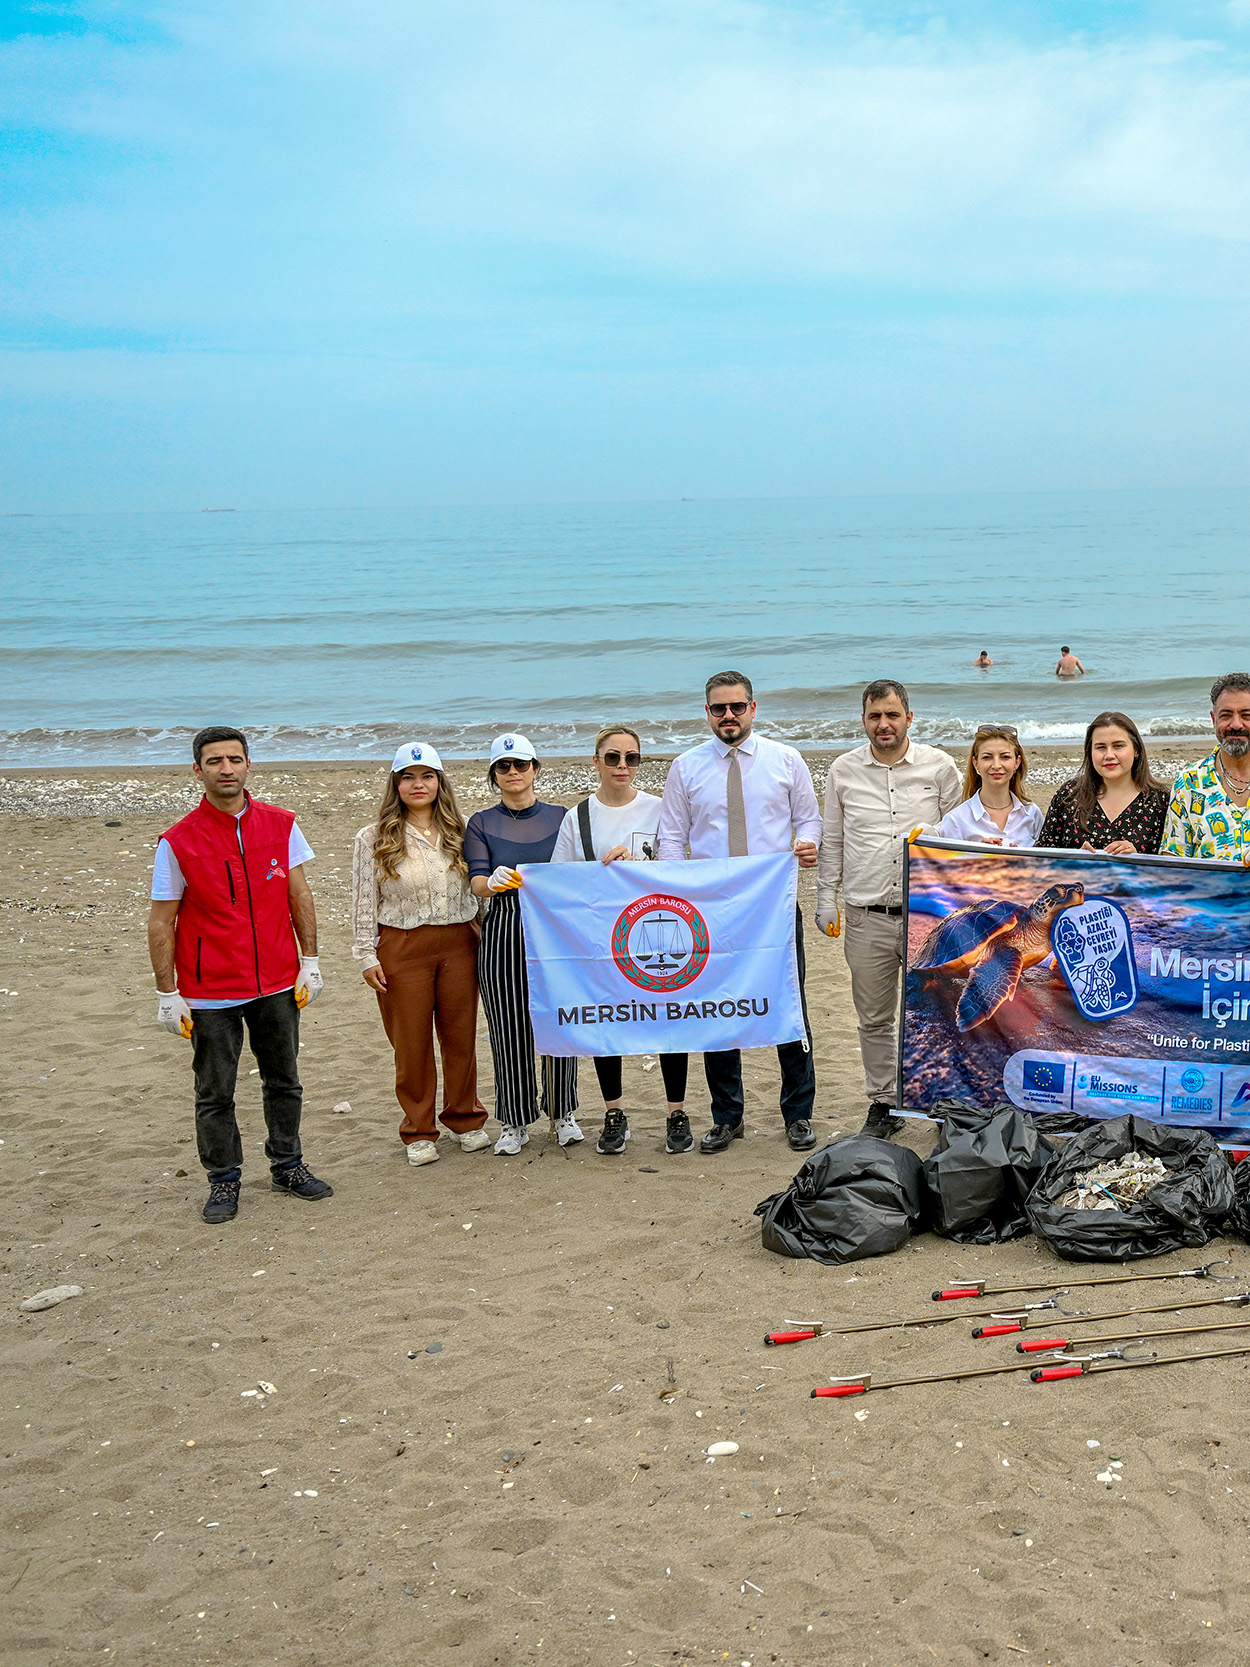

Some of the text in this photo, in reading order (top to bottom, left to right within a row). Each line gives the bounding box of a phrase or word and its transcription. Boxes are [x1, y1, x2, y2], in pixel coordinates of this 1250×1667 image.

[627, 897, 692, 918] MERSİN BAROSU
[558, 997, 769, 1025] MERSİN BAROSU
[1191, 1036, 1211, 1050] for
[1090, 1082, 1138, 1094] MISSIONS
[1171, 1096, 1213, 1111] REMEDIES
